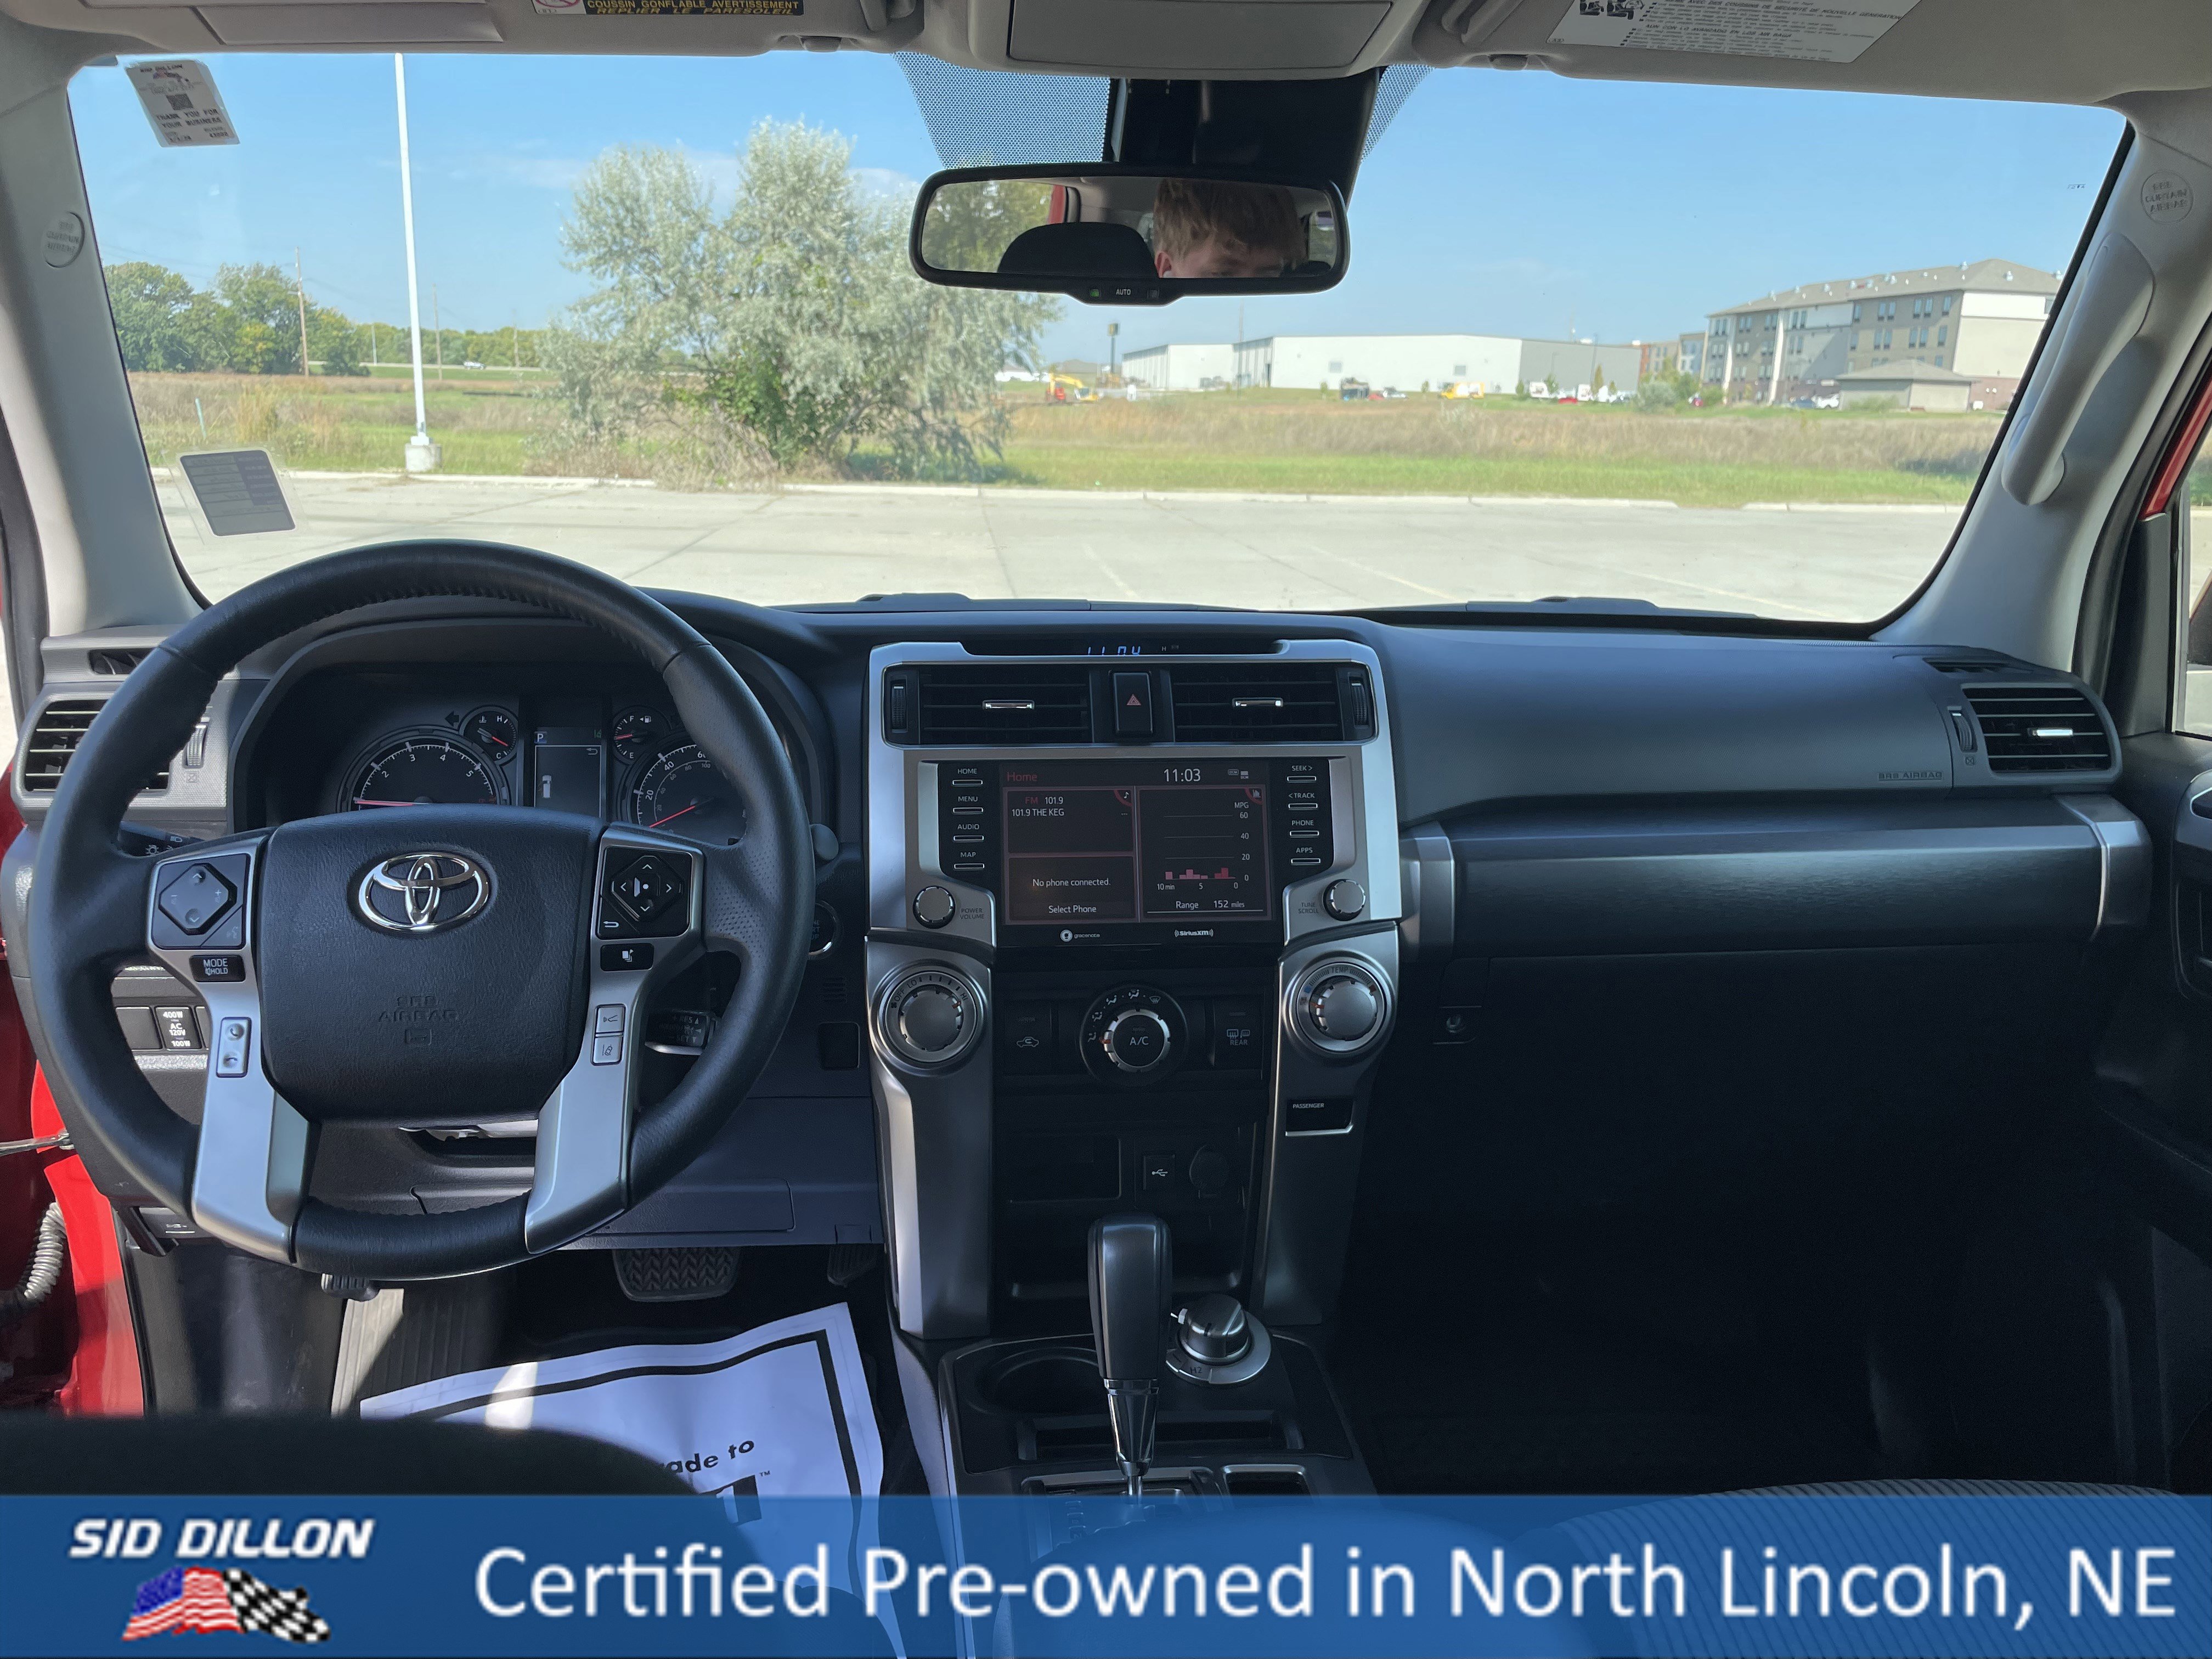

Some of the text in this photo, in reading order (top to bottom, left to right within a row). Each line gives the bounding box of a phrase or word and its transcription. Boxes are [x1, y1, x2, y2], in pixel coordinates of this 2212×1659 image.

[587, 0, 636, 8] COUSSIN
[712, 1, 799, 9] AVERTISSEMENT
[537, 733, 544, 742] P
[410, 754, 416, 763] 3
[439, 754, 447, 762] 4
[664, 760, 675, 772] 40
[381, 770, 390, 778] 2
[466, 770, 474, 778] 5
[1007, 771, 1038, 782] Home
[1163, 769, 1201, 782] 11:03
[646, 789, 654, 802] 20
[1045, 797, 1064, 805] 101.9
[1012, 808, 1064, 817] 101.9 THE KEG
[1032, 878, 1111, 888] No phone connected.
[1233, 882, 1239, 890] 0
[1048, 905, 1097, 914] Select Phone
[1176, 900, 1245, 910] Range 152 miles
[203, 958, 229, 968] MODE
[906, 979, 918, 989] LO
[893, 988, 906, 1002] OFF
[960, 992, 969, 1001] HI
[162, 1011, 184, 1019] 400W
[1130, 1036, 1150, 1046] A/C
[728, 1440, 755, 1459] to
